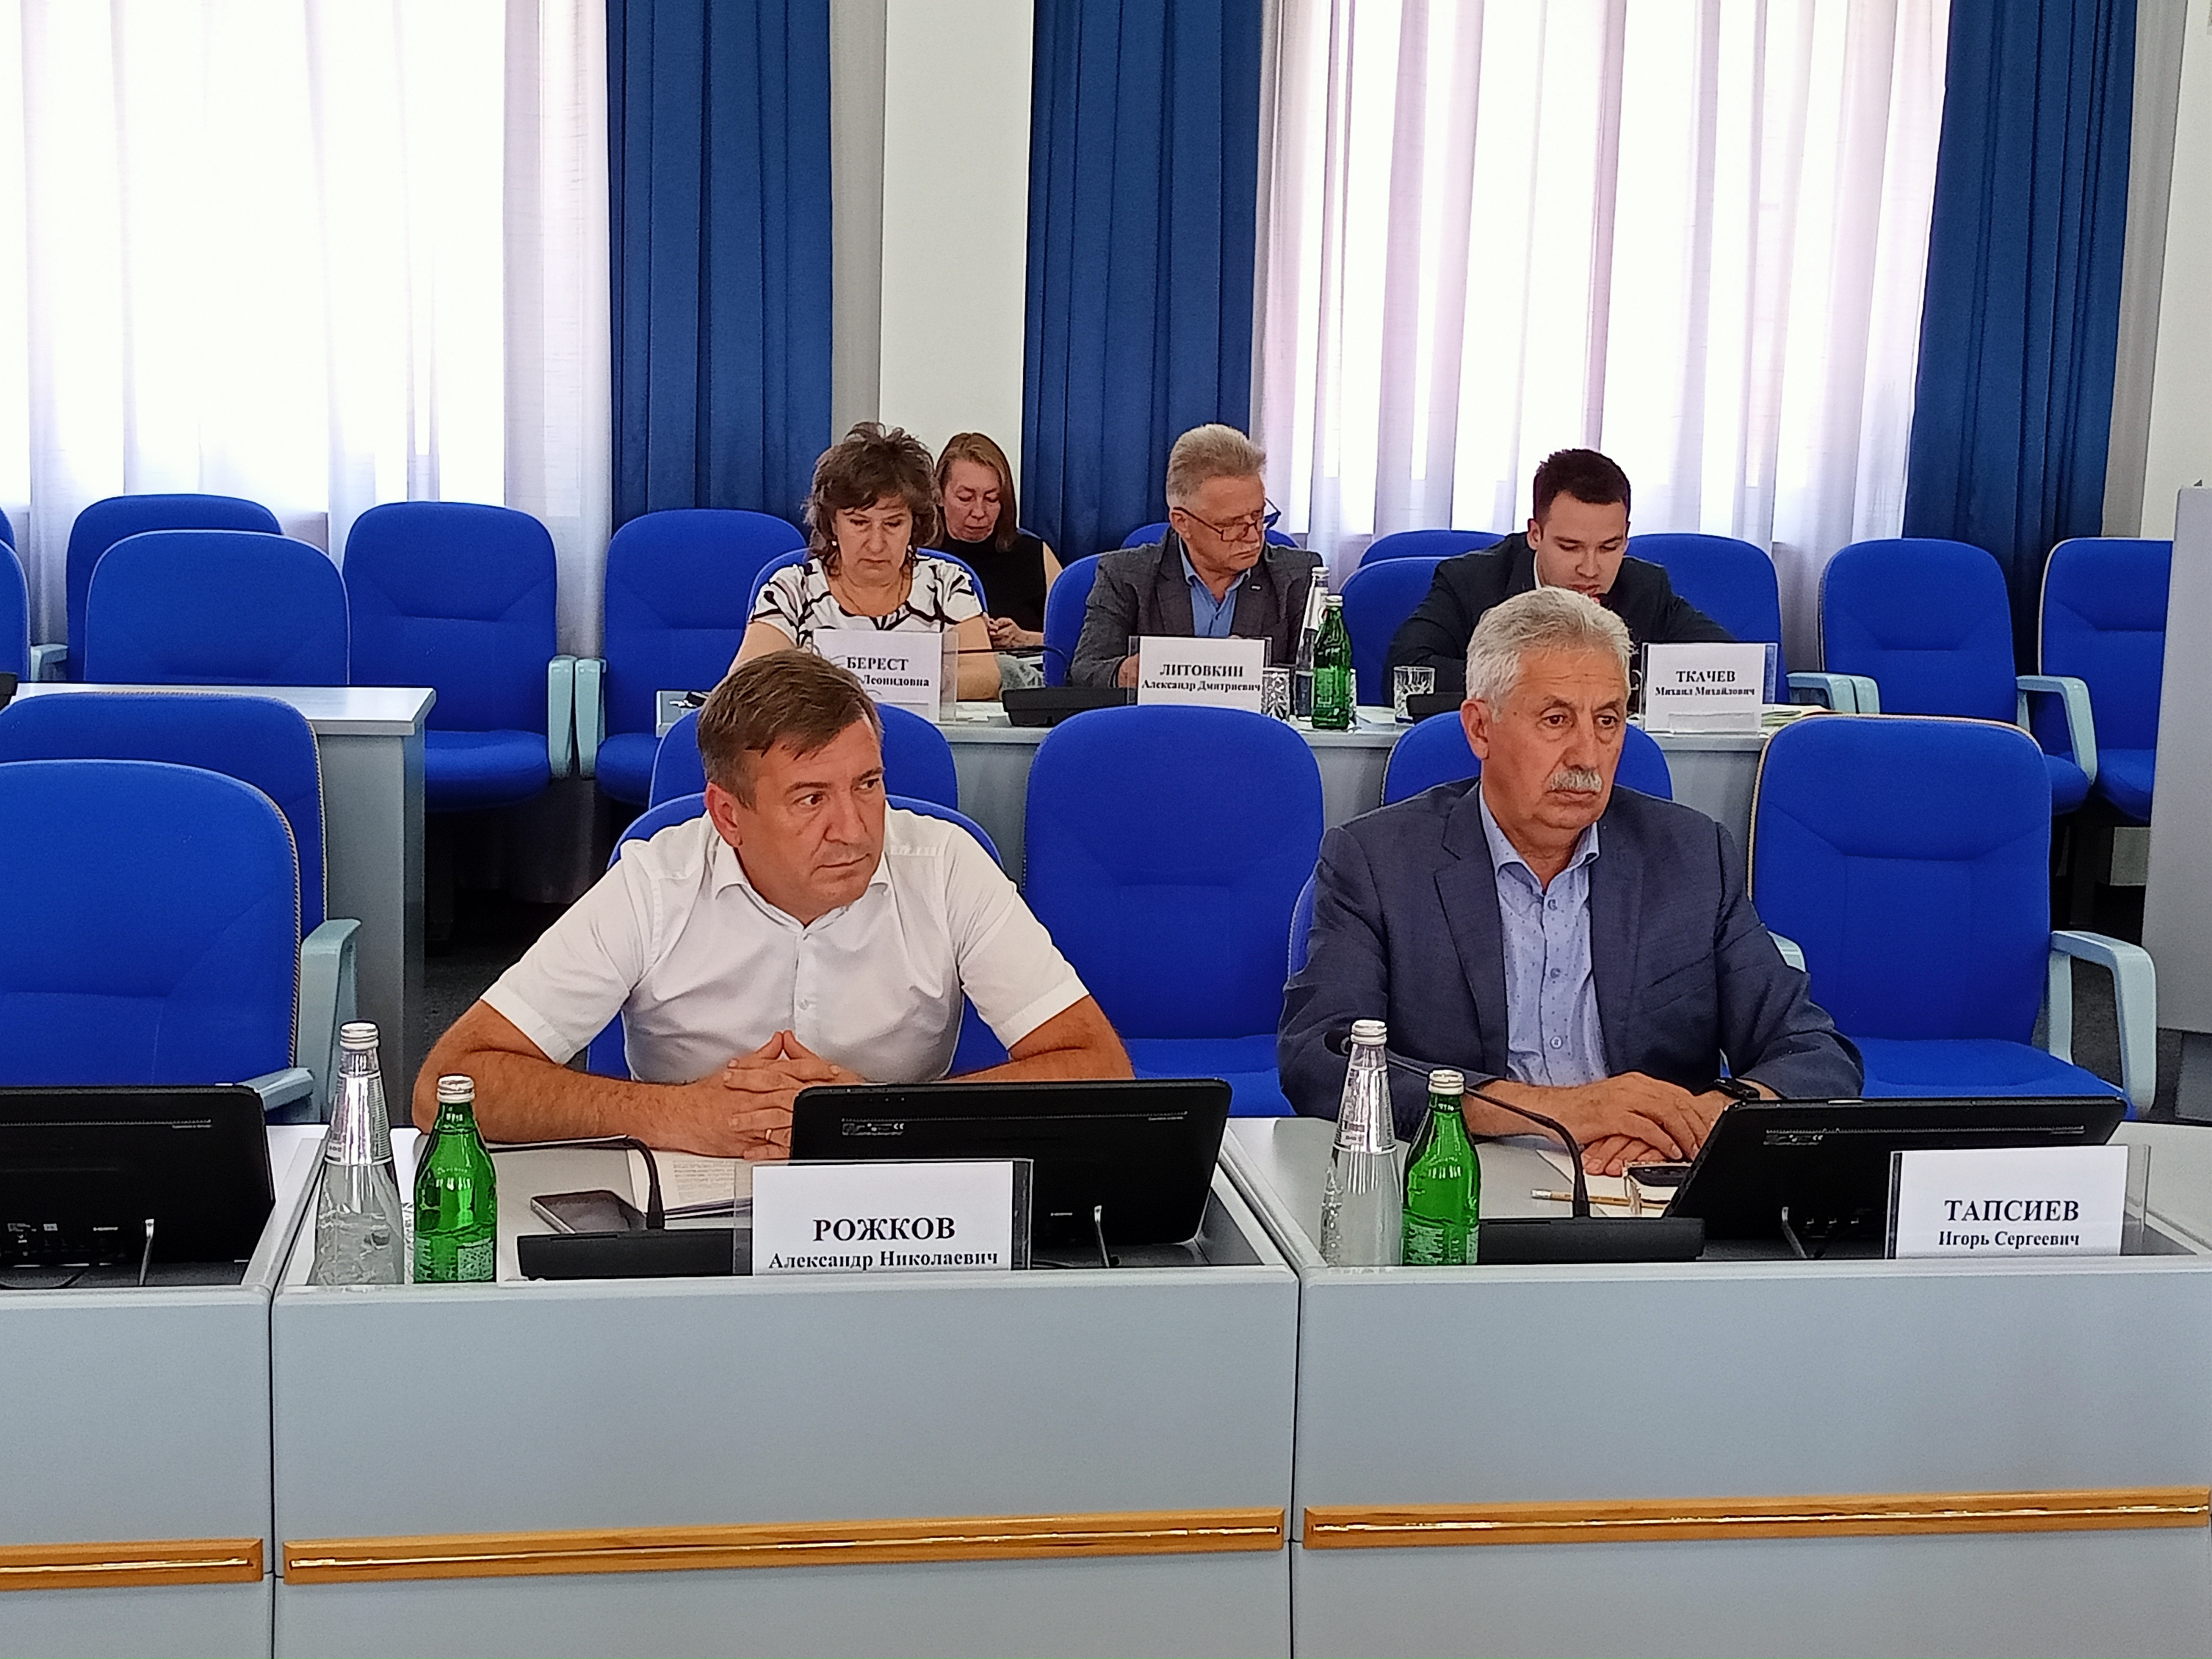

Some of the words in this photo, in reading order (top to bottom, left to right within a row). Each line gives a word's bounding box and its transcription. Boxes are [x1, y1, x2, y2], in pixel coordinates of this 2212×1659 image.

[847, 656, 909, 671] БЕРЕСТ
[1160, 664, 1243, 677] ЛИТОВКИН
[863, 674, 930, 686] Леонидовна
[1676, 670, 1735, 682] ТКАЧЕВ
[1141, 680, 1196, 691] Александр
[1197, 680, 1261, 692] Дмитриевич
[1655, 686, 1693, 696] Михаил
[1695, 686, 1755, 696] Михайлович
[1944, 1199, 2079, 1221] ТАПСИЕВ
[813, 1217, 956, 1241] РОЖКОВ
[1938, 1231, 1990, 1249] Игорь
[1994, 1230, 2079, 1249] Сергеевич
[768, 1253, 873, 1271] Александр
[879, 1250, 998, 1267] Николаевич
